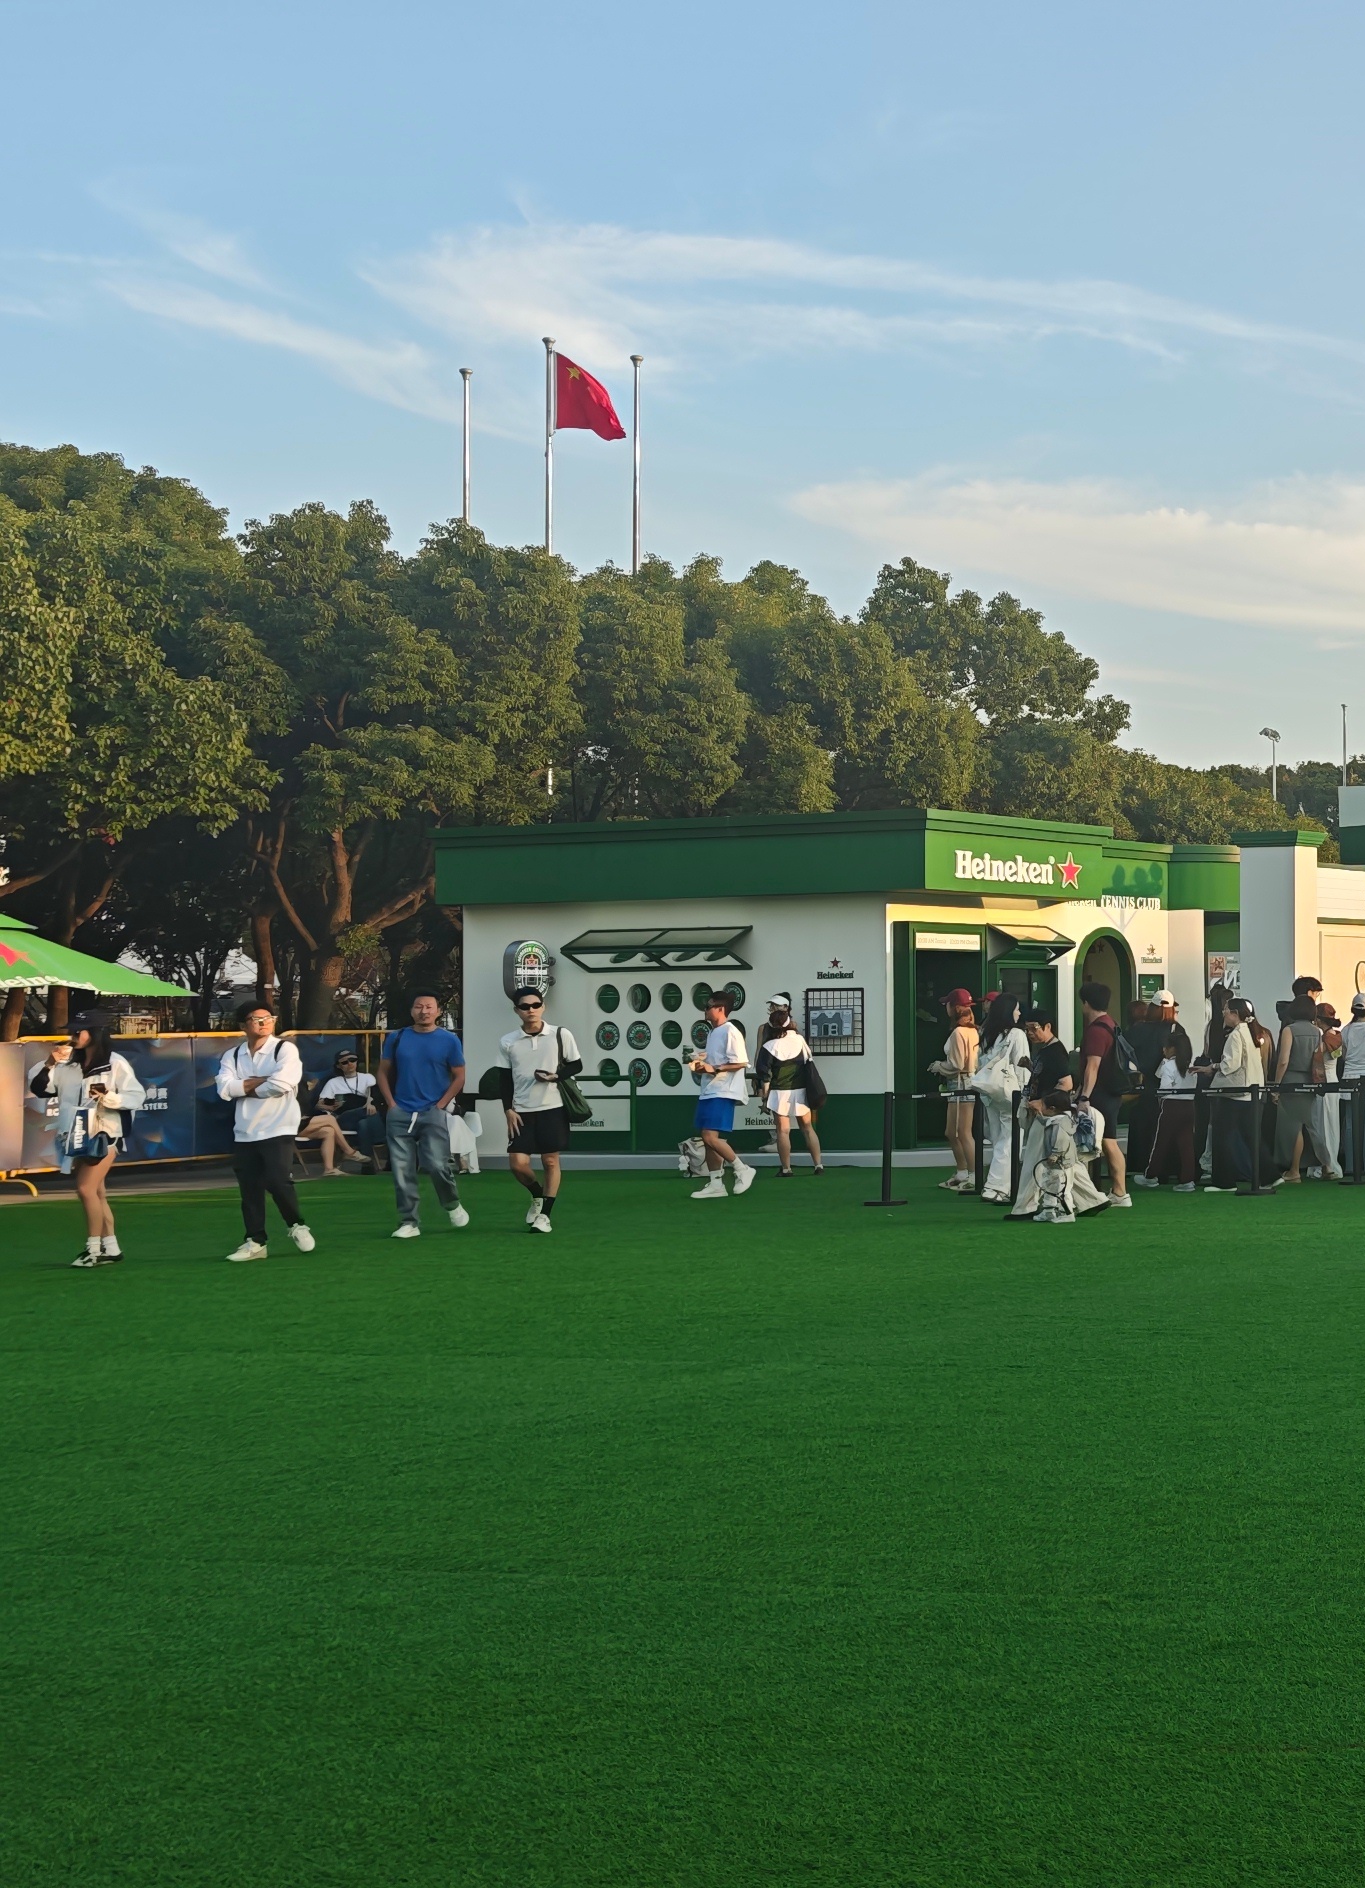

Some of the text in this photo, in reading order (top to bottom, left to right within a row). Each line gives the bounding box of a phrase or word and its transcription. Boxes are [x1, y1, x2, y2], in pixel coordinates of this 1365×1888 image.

[954, 849, 1054, 885] Heineken
[1101, 894, 1135, 910] TENNIS
[1136, 897, 1161, 911] CLUB
[816, 970, 854, 980] Heineken
[745, 1117, 777, 1128] Heinek
